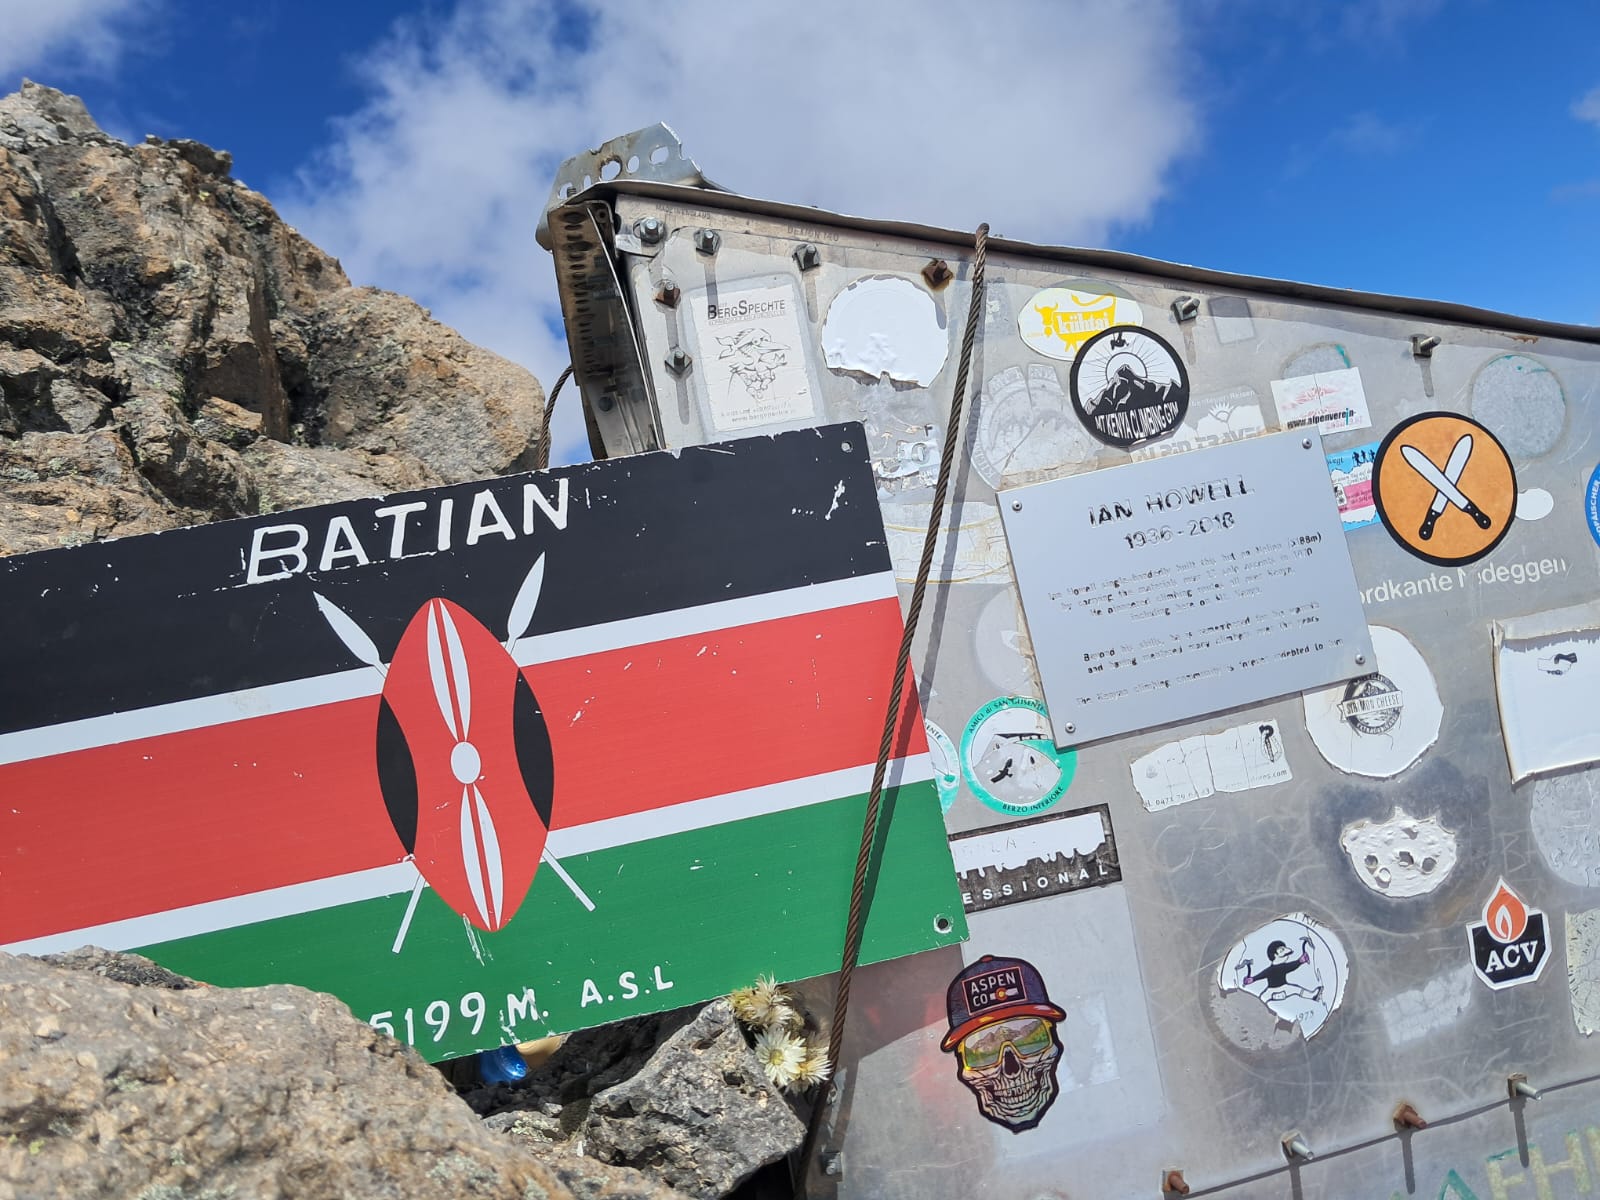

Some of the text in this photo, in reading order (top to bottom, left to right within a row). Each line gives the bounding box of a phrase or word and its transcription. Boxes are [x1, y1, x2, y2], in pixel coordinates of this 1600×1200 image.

[1095, 401, 1179, 440] MT KENYA CLIMBING GYM
[1089, 475, 1255, 528] IAN HOWELL
[246, 478, 569, 585] BATIAN
[969, 712, 985, 734] AMICI
[994, 699, 1008, 708] SAN
[1377, 692, 1399, 708] CHEESE
[1002, 786, 1063, 813] BERZO INFERIORE
[962, 865, 1108, 905] ESSIONAL
[1485, 940, 1538, 973] ACV
[971, 971, 1016, 995] ASPEN
[973, 993, 988, 1007] CO
[369, 991, 486, 1046] 5199
[581, 965, 674, 1008] A.S.L
